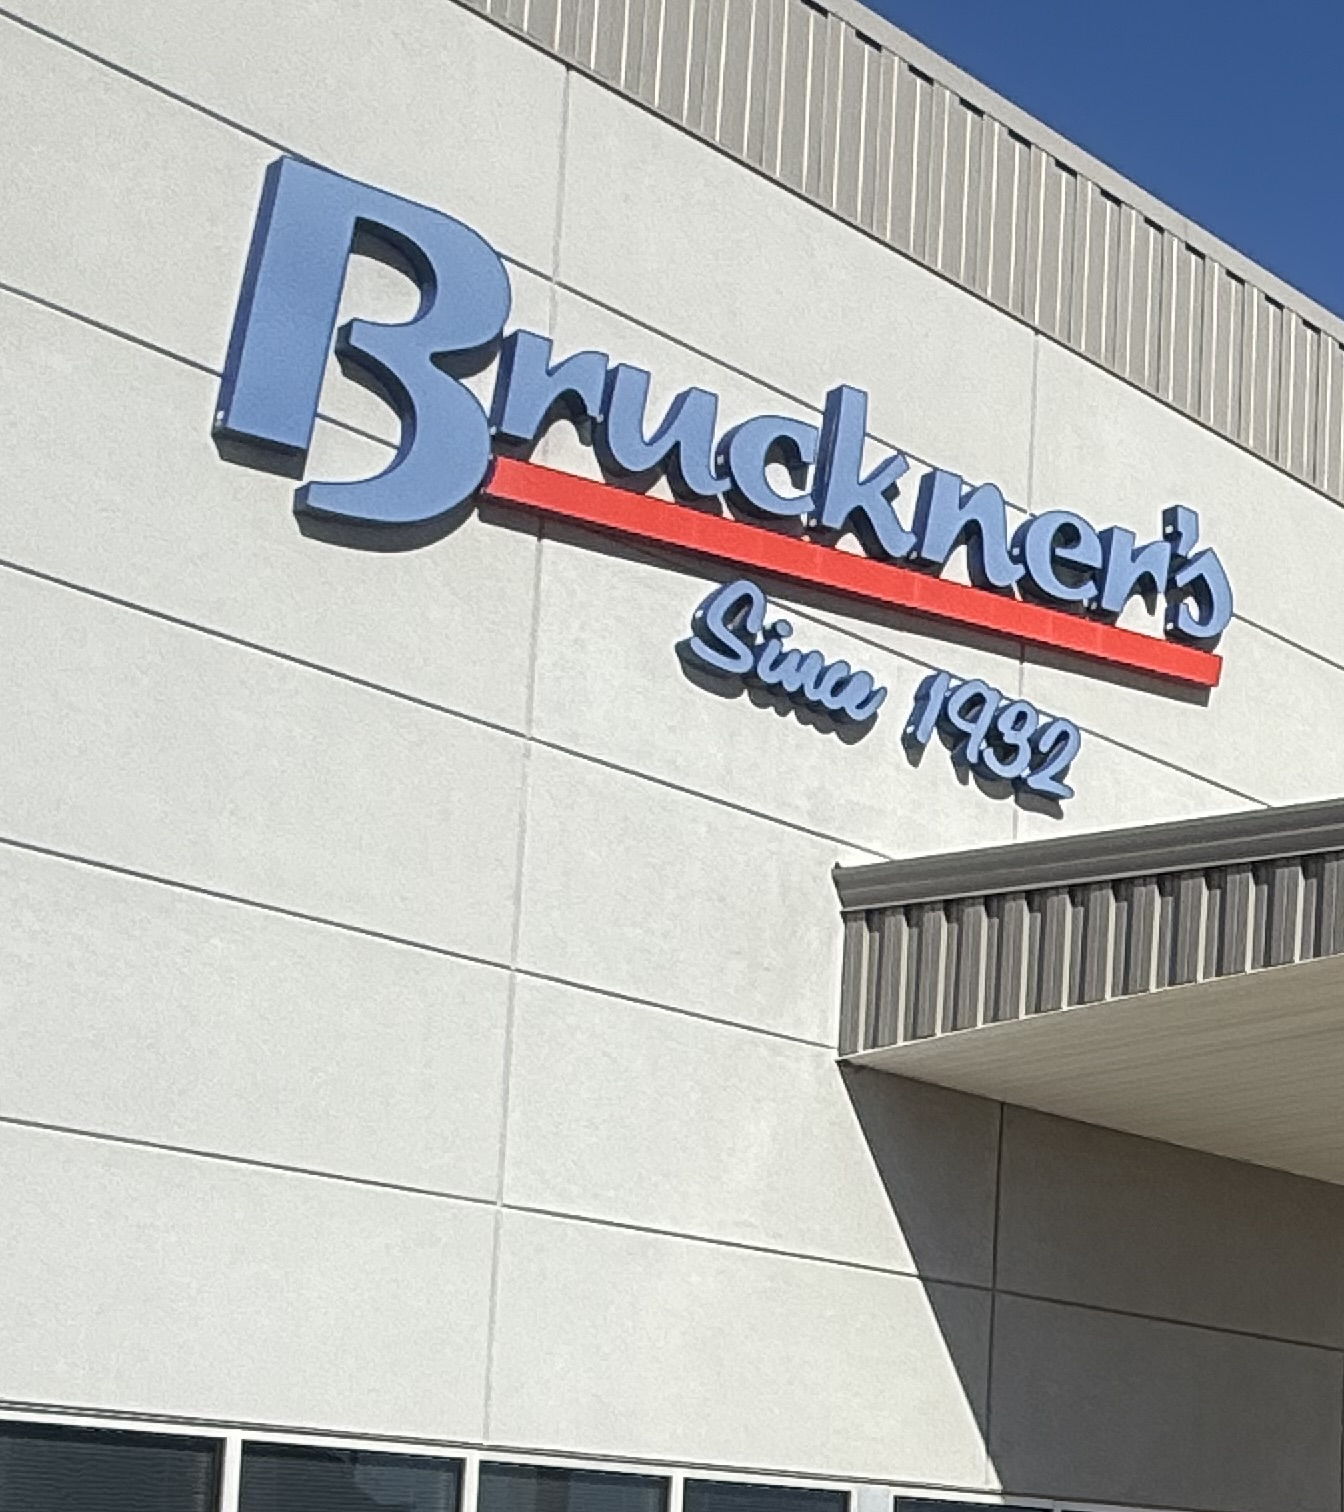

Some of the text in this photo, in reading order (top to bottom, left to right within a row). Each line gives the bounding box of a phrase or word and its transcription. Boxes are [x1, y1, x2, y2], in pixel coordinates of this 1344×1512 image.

[214, 155, 1233, 642] Bruckner's
[686, 579, 1082, 800] Since 1932
